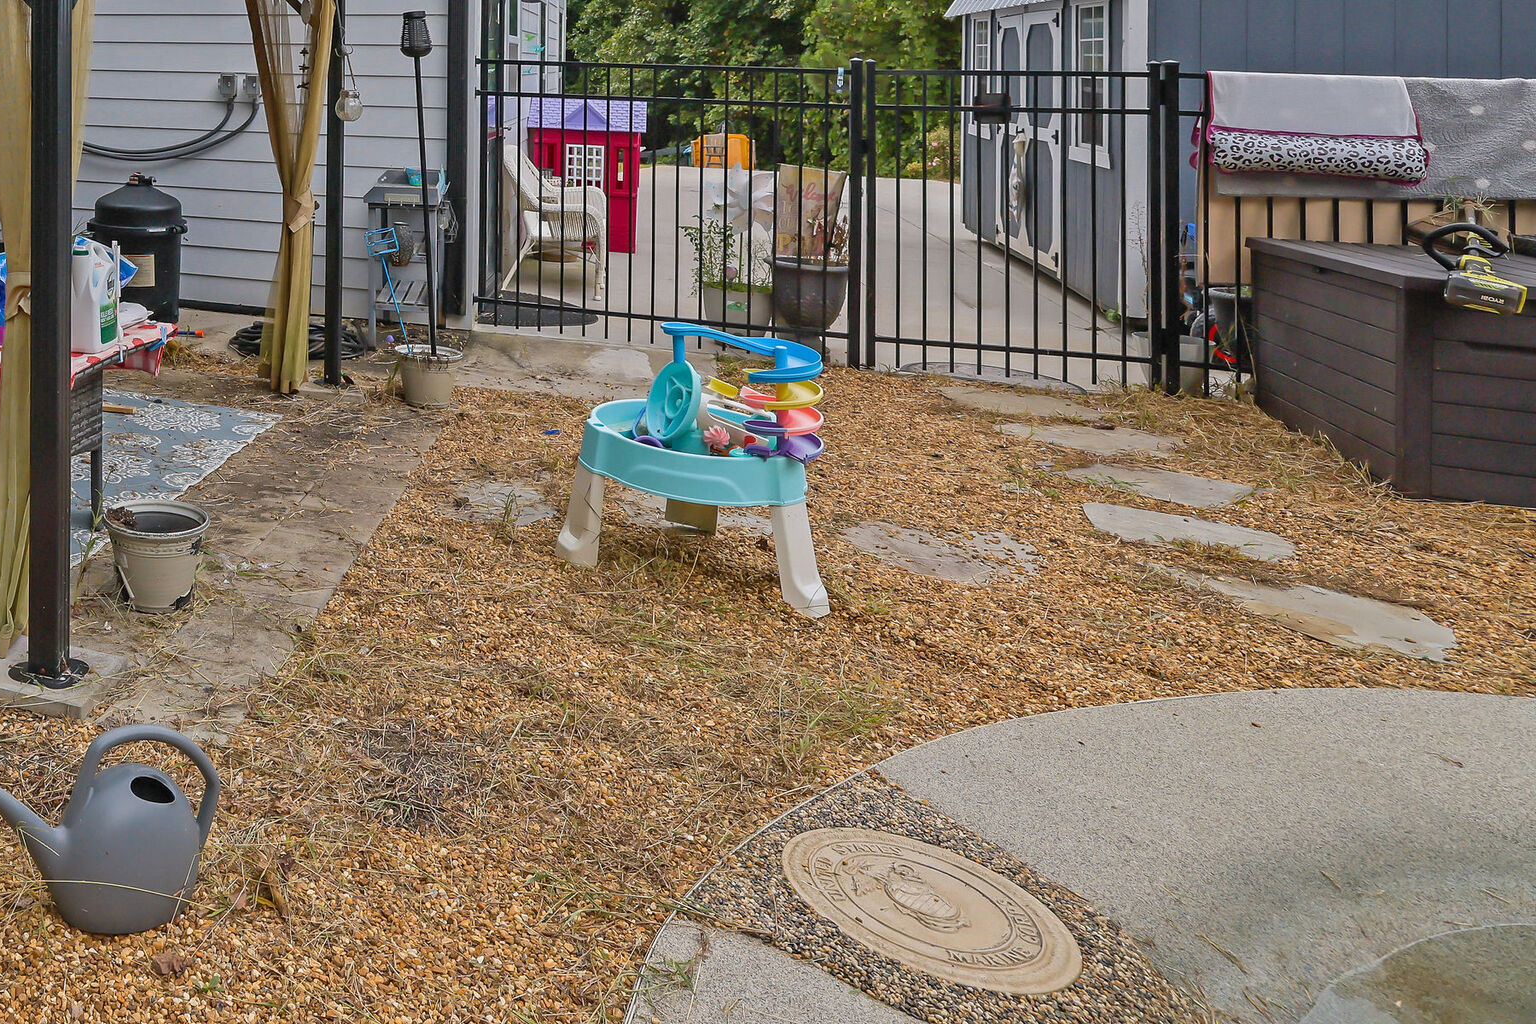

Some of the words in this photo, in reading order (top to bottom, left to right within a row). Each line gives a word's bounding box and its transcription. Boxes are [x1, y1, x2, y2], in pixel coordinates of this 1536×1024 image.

[1480, 295, 1505, 304] RYOBI
[831, 843, 903, 856] STATES
[947, 947, 1034, 965] MARINE
